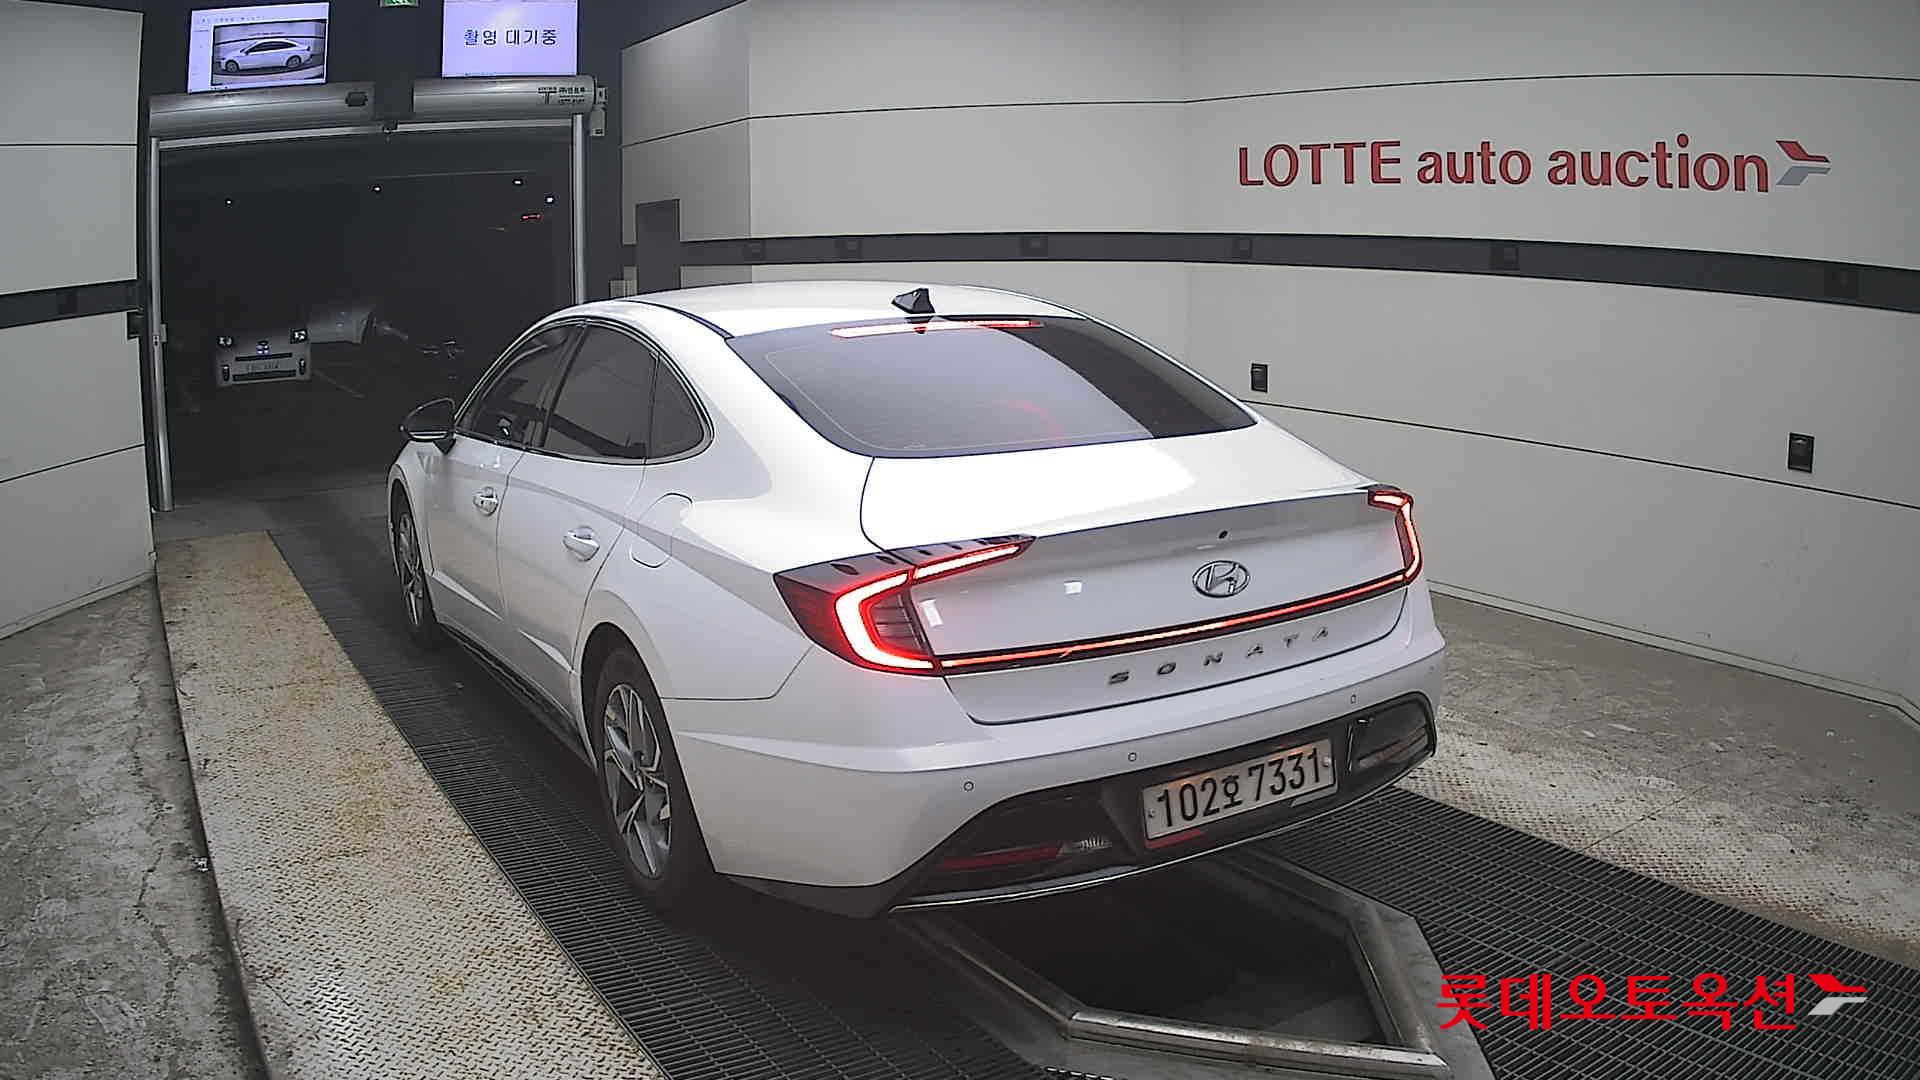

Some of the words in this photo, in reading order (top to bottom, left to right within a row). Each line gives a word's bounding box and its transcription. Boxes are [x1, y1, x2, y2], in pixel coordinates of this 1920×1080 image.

[505, 28, 558, 46] 대기중
[1238, 140, 1401, 186] LOTTE
[1416, 141, 1533, 186] auto
[1547, 133, 1769, 193] auction
[1108, 626, 1329, 686] SONATA
